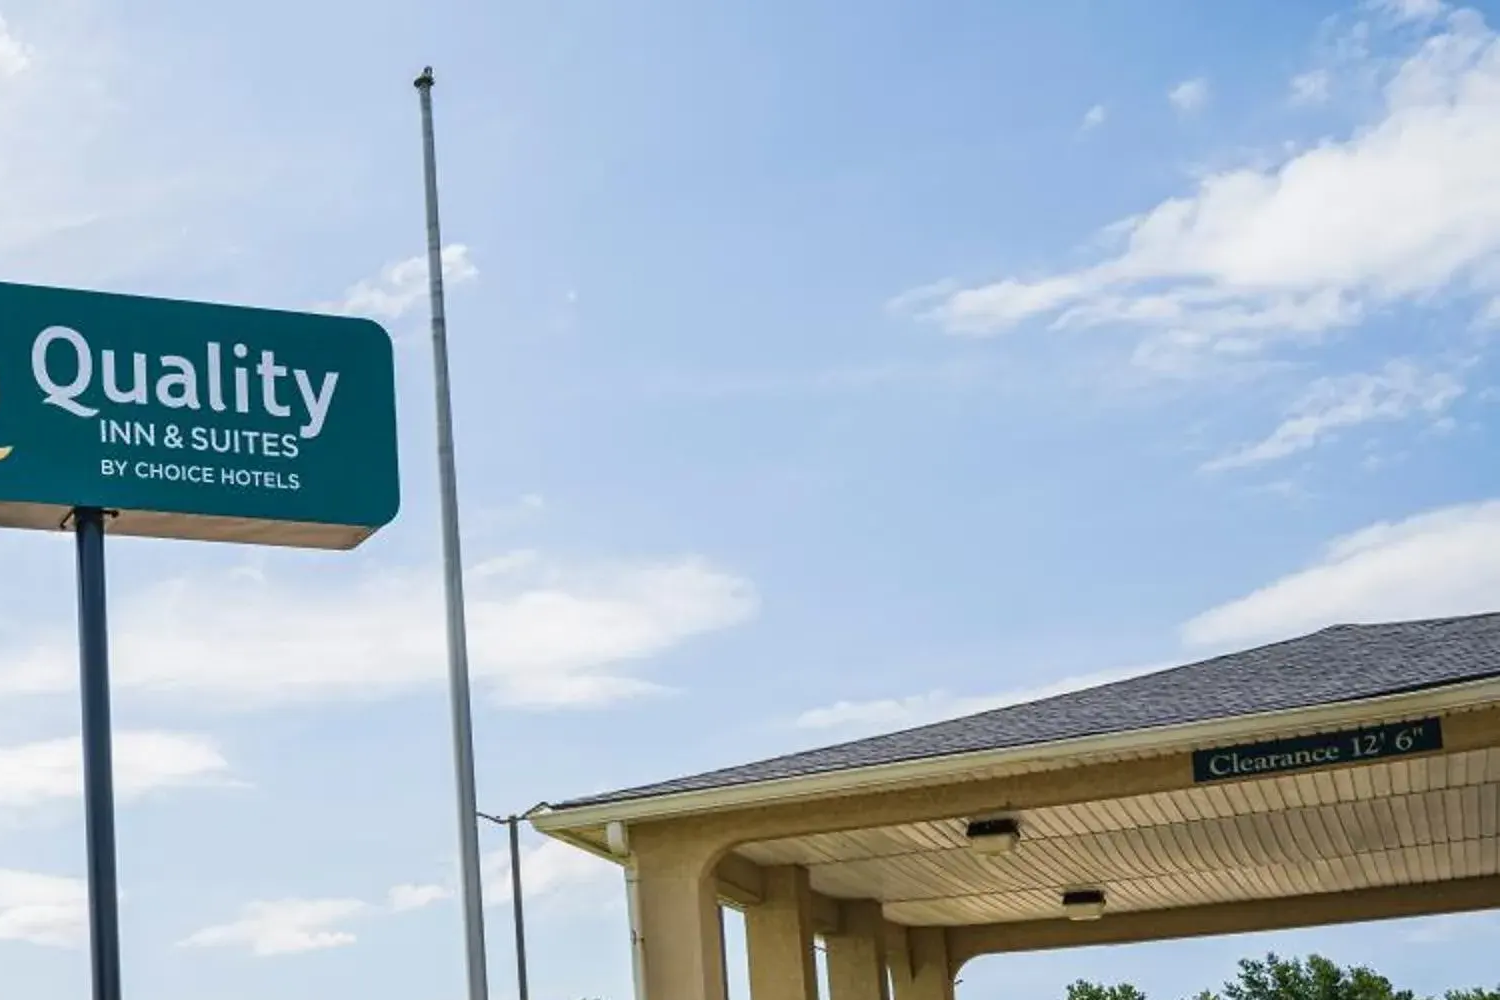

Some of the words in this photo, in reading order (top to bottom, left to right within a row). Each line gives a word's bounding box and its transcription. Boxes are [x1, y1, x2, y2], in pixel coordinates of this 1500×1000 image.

[31, 325, 340, 438] Quality
[100, 419, 155, 446] INN
[163, 424, 184, 449] &
[191, 426, 299, 458] SUITES
[100, 459, 128, 477] BY
[134, 461, 215, 484] CHOICE
[220, 467, 301, 490] HOTELS
[1208, 743, 1340, 776] Clearance
[1351, 731, 1386, 757] 12'
[1394, 726, 1424, 751] 6"
